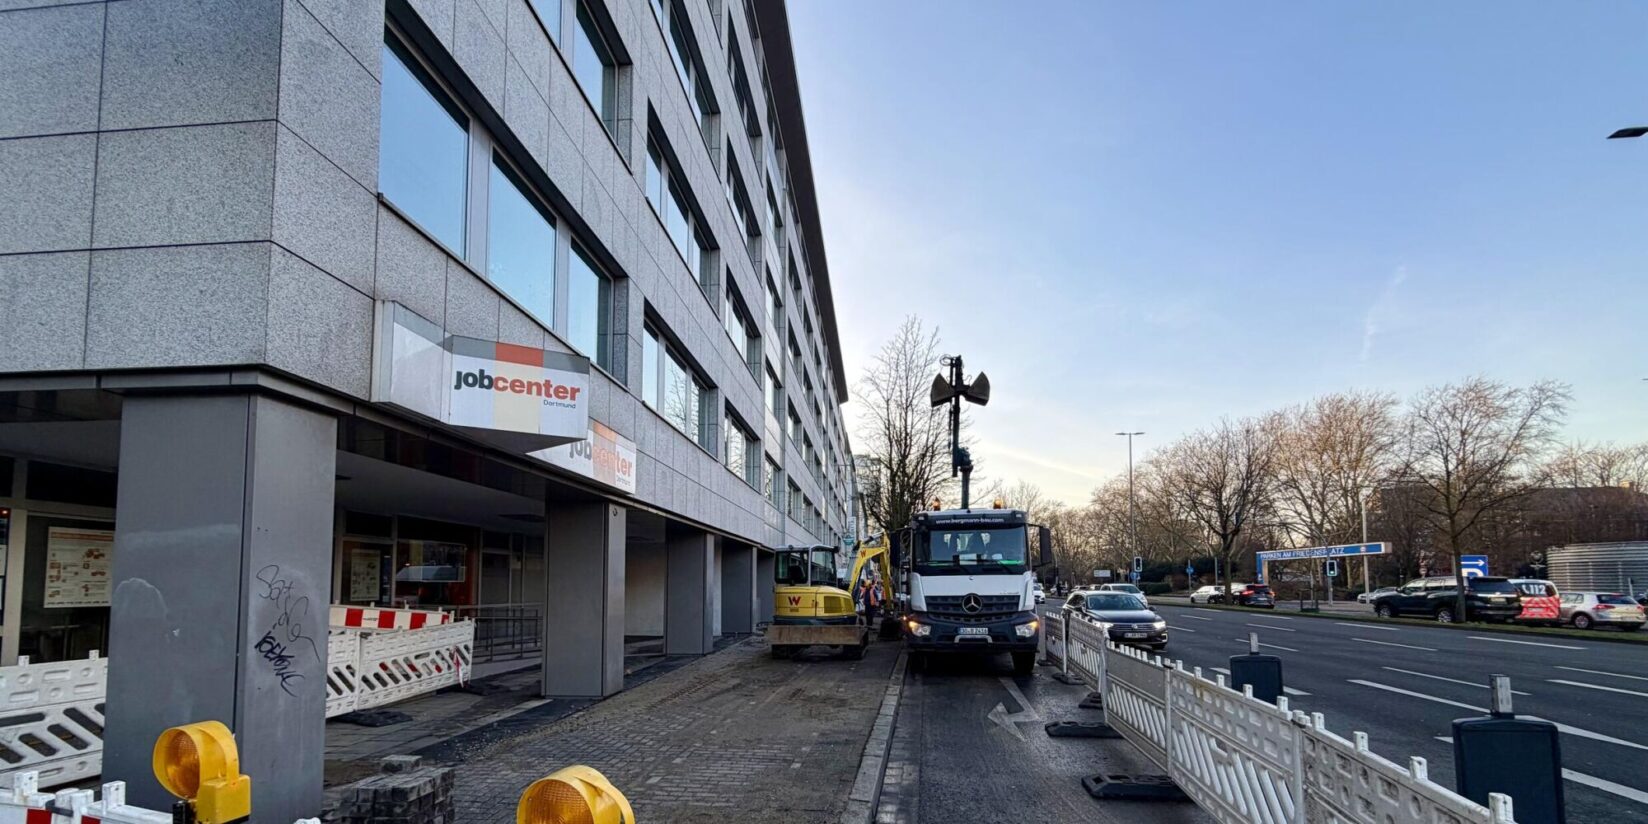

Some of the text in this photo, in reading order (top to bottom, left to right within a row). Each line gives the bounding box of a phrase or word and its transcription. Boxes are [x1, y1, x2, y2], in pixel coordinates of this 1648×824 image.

[454, 369, 580, 401] jobcenter
[544, 399, 576, 409] Dortmund
[569, 440, 632, 477] jobcenter
[1260, 551, 1281, 559] PARKEN
[1282, 550, 1291, 558] AM
[1529, 584, 1546, 595] 112
[788, 596, 801, 606] W
